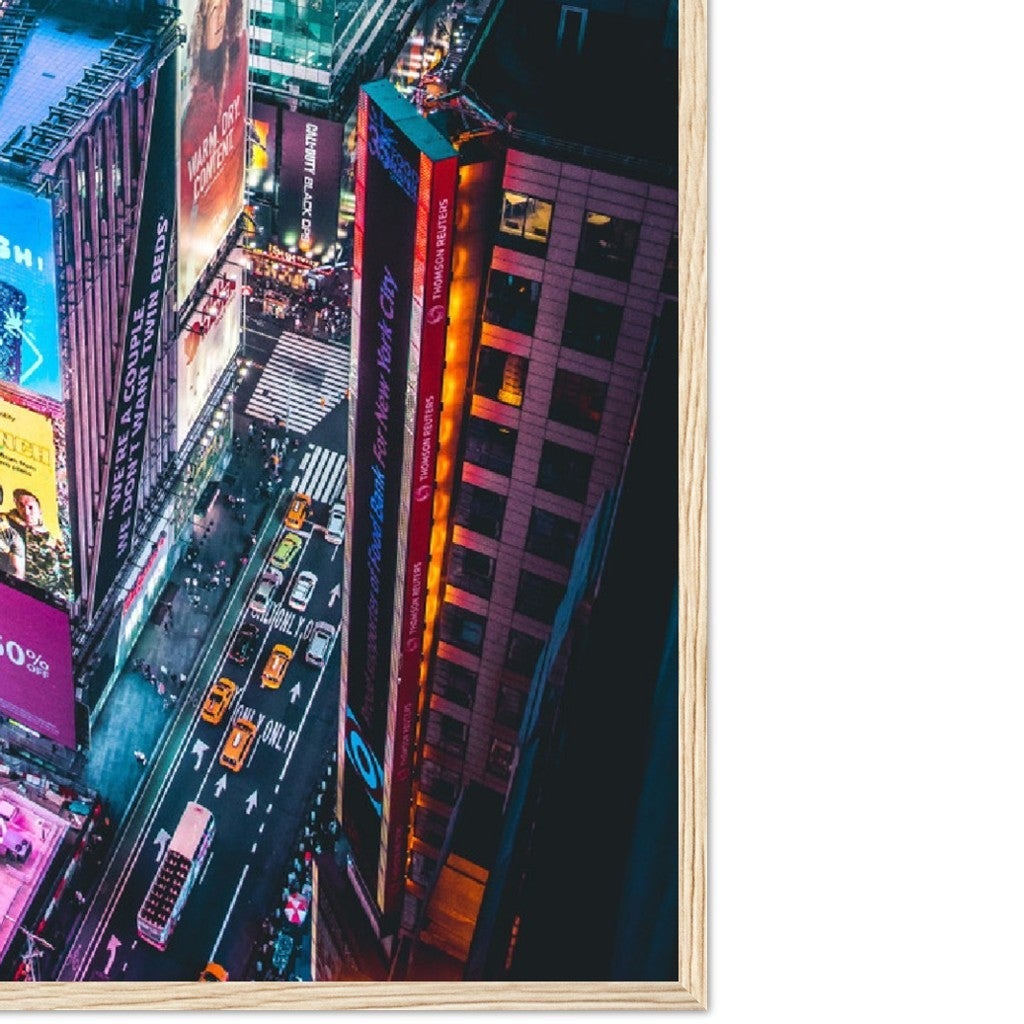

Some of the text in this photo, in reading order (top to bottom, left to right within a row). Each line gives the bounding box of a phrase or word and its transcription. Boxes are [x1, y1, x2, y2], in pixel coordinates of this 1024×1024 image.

[302, 176, 314, 218] BLACK
[432, 197, 449, 300] THOMSON REUTERS
[379, 264, 399, 320] City
[130, 363, 151, 438] WANT
[141, 288, 159, 360] TWIN
[376, 318, 392, 375] York
[119, 405, 133, 425] A
[419, 395, 435, 482] THOMSON REUTERS
[274, 608, 306, 638] ONLY
[26, 663, 50, 679] OFF
[262, 719, 297, 754] ONLY
